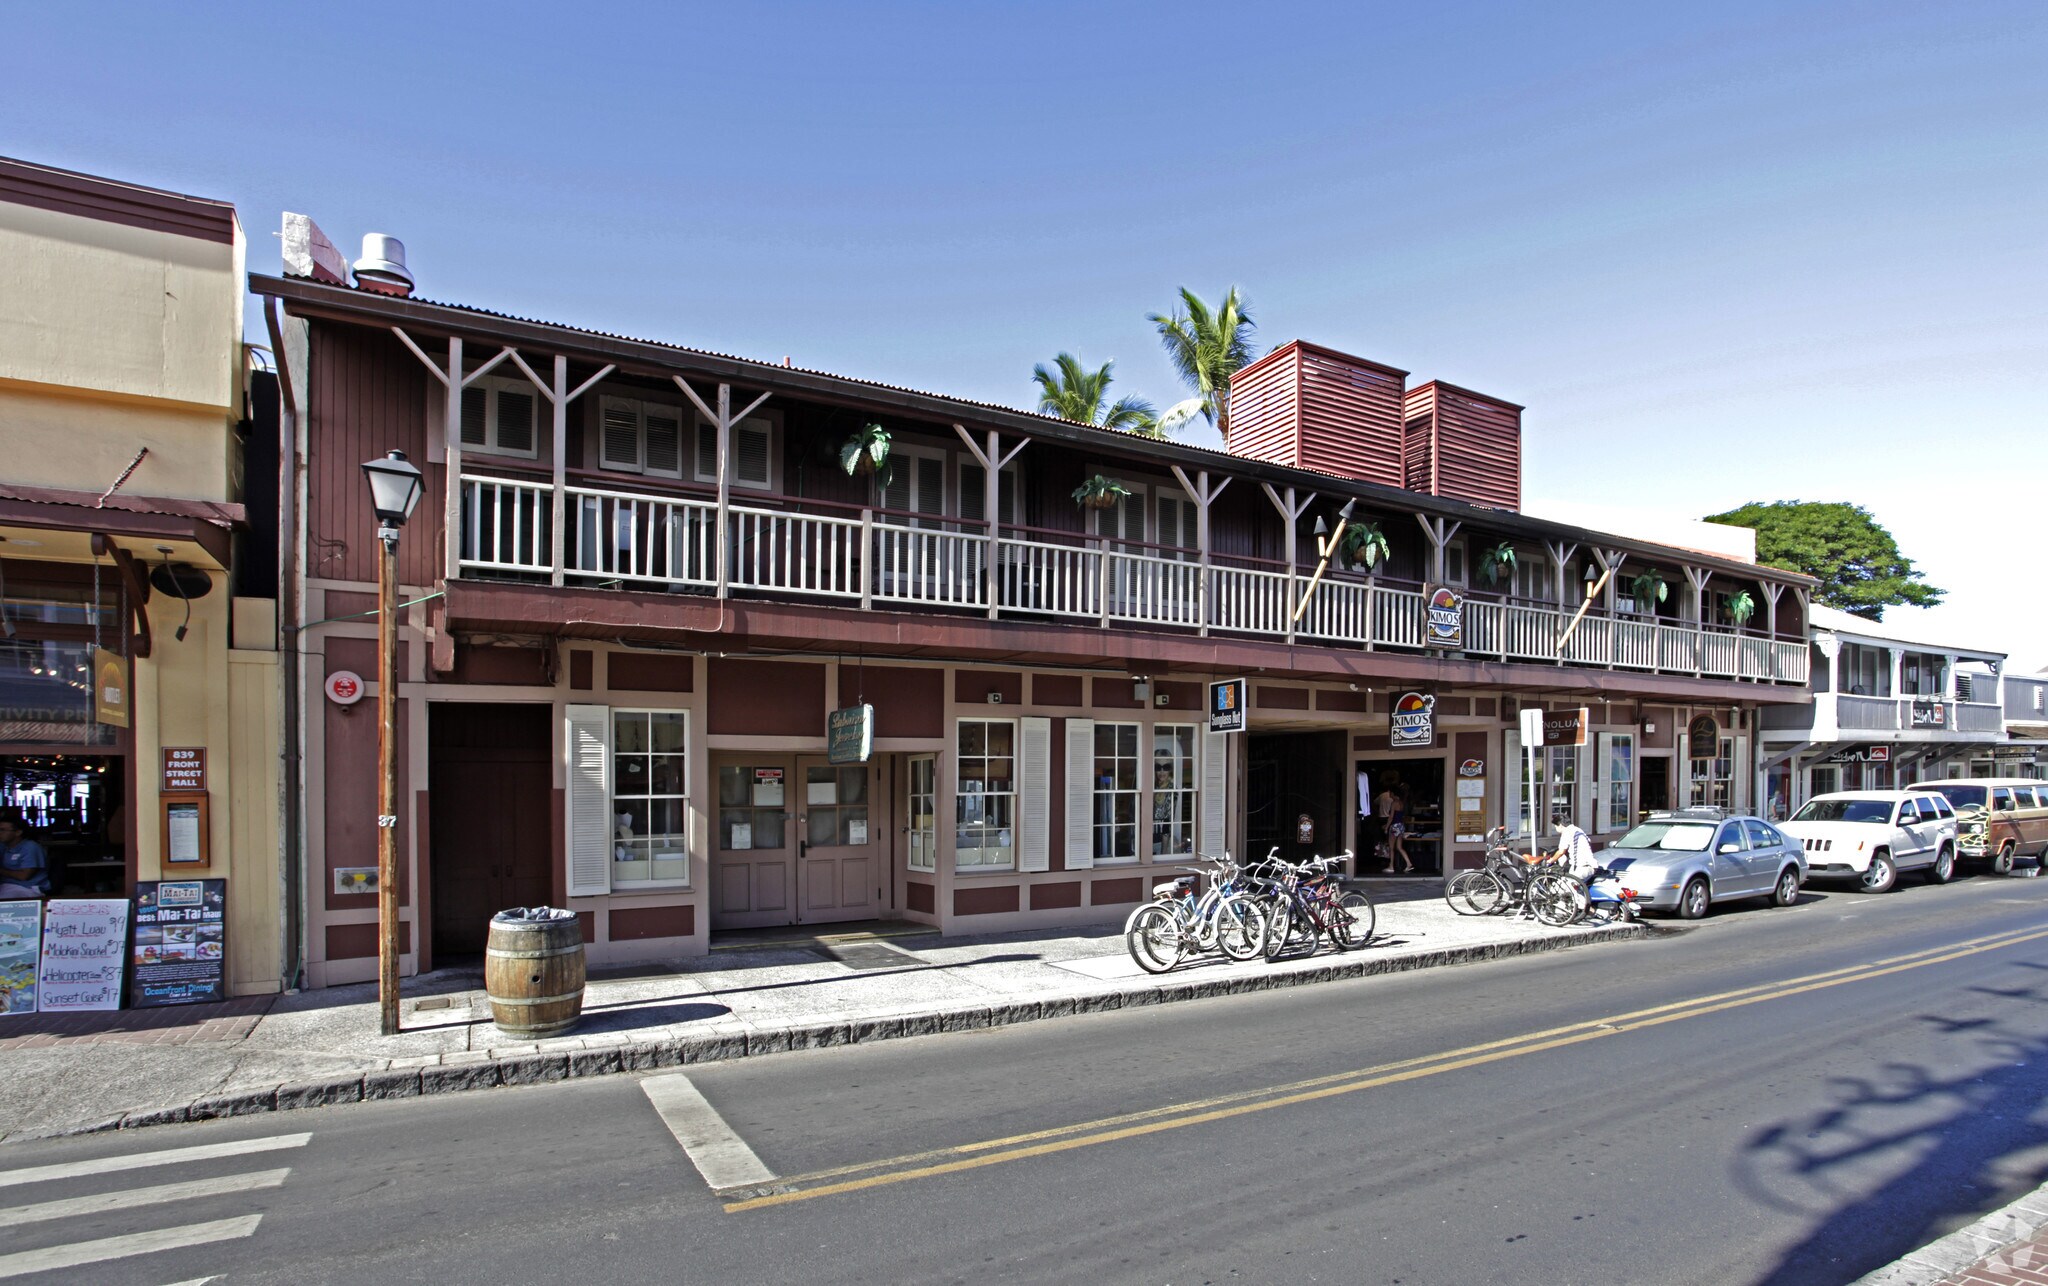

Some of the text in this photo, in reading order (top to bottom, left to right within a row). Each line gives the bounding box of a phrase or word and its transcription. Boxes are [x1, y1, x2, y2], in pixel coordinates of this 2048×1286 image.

[1212, 711, 1241, 728] Sunglass Hut
[1395, 715, 1429, 727] KIMO'S
[1542, 718, 1580, 730] NOLUA
[173, 751, 195, 759] 839
[168, 761, 200, 769] FRONT
[172, 779, 197, 787] MALL
[378, 815, 396, 828] 37
[157, 908, 201, 922] Mai-Tai
[43, 991, 79, 1007] Sunset
